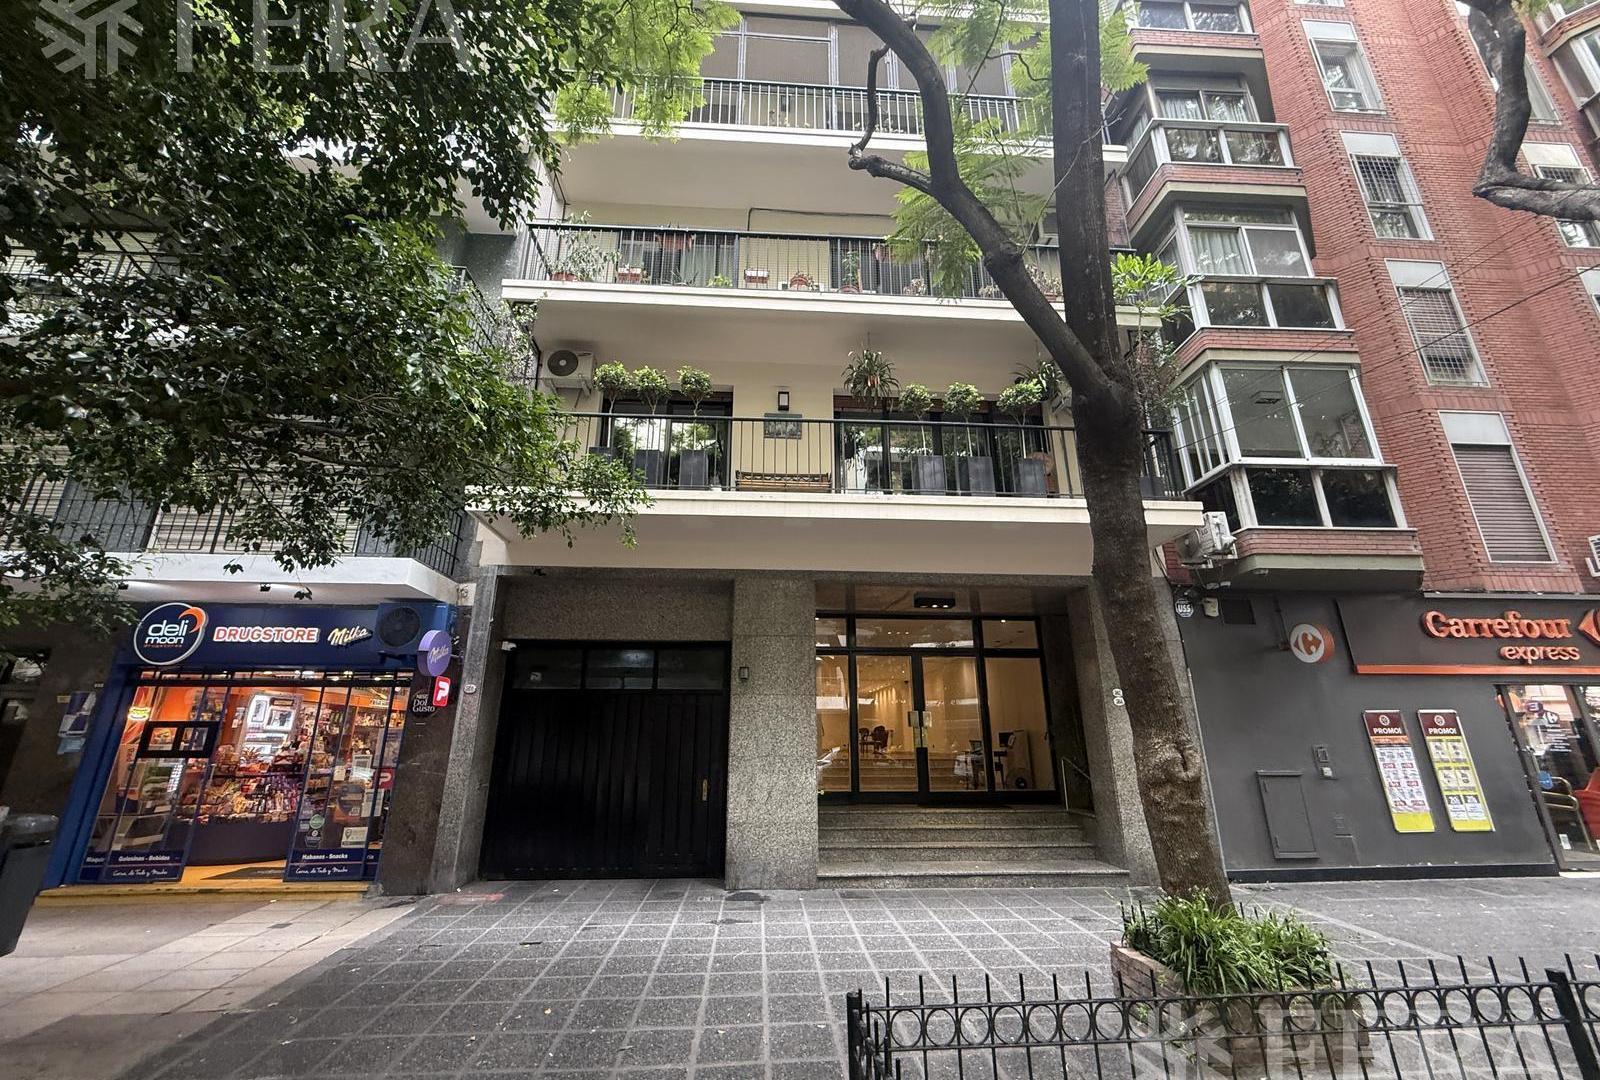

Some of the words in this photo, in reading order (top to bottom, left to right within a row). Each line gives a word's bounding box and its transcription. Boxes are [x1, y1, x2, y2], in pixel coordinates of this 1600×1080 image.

[1177, 604, 1191, 613] USS
[147, 619, 190, 637] deli
[1422, 610, 1573, 639] Carrefour
[144, 636, 185, 645] moon
[213, 626, 320, 643] DRUGSTORE
[327, 626, 372, 646] Milka
[1500, 646, 1581, 664] express
